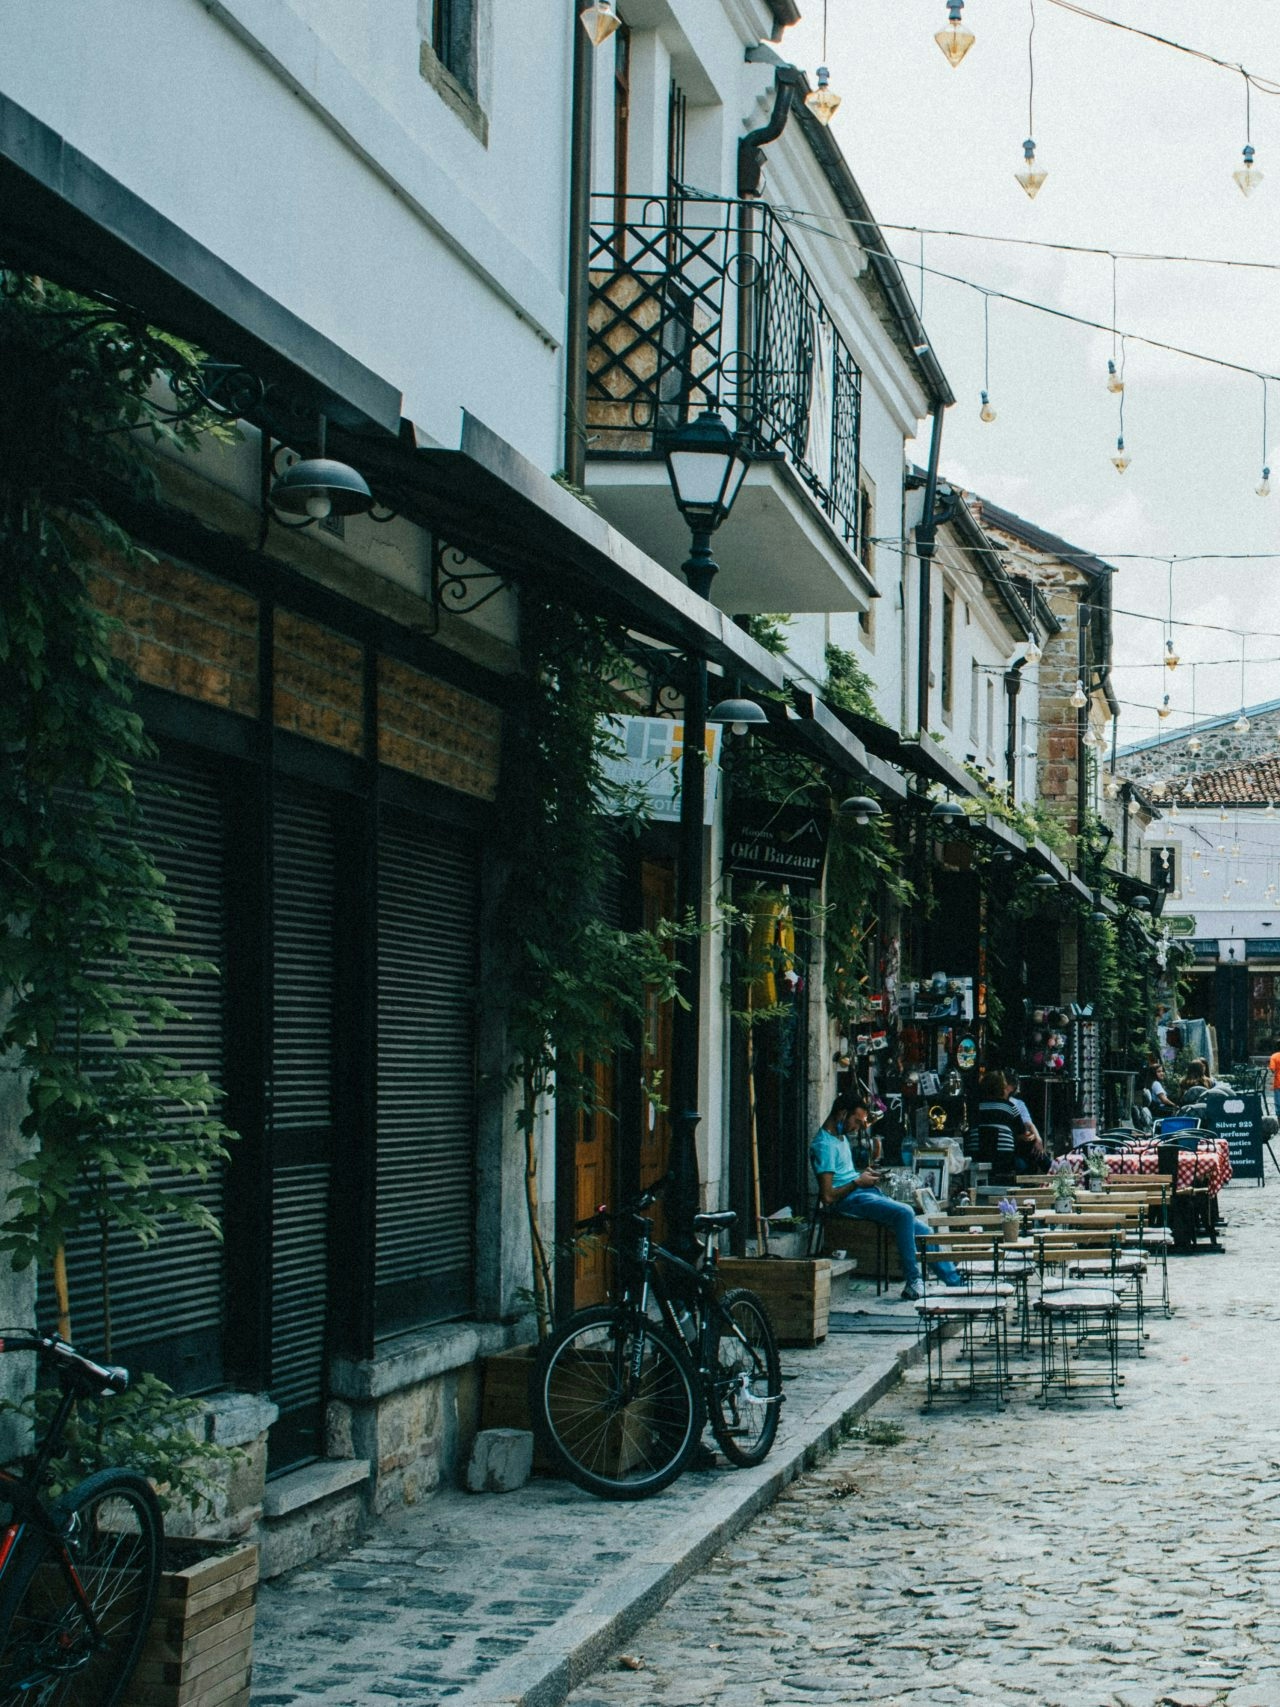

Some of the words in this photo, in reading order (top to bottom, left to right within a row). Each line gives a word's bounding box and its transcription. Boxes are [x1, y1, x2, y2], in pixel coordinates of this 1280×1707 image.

[742, 826, 774, 840] Rooms
[730, 841, 760, 860] Old
[764, 846, 820, 869] Bazaar
[1238, 1120, 1253, 1128] 925
[1220, 1130, 1250, 1139] perfume
[1229, 1148, 1243, 1156] and
